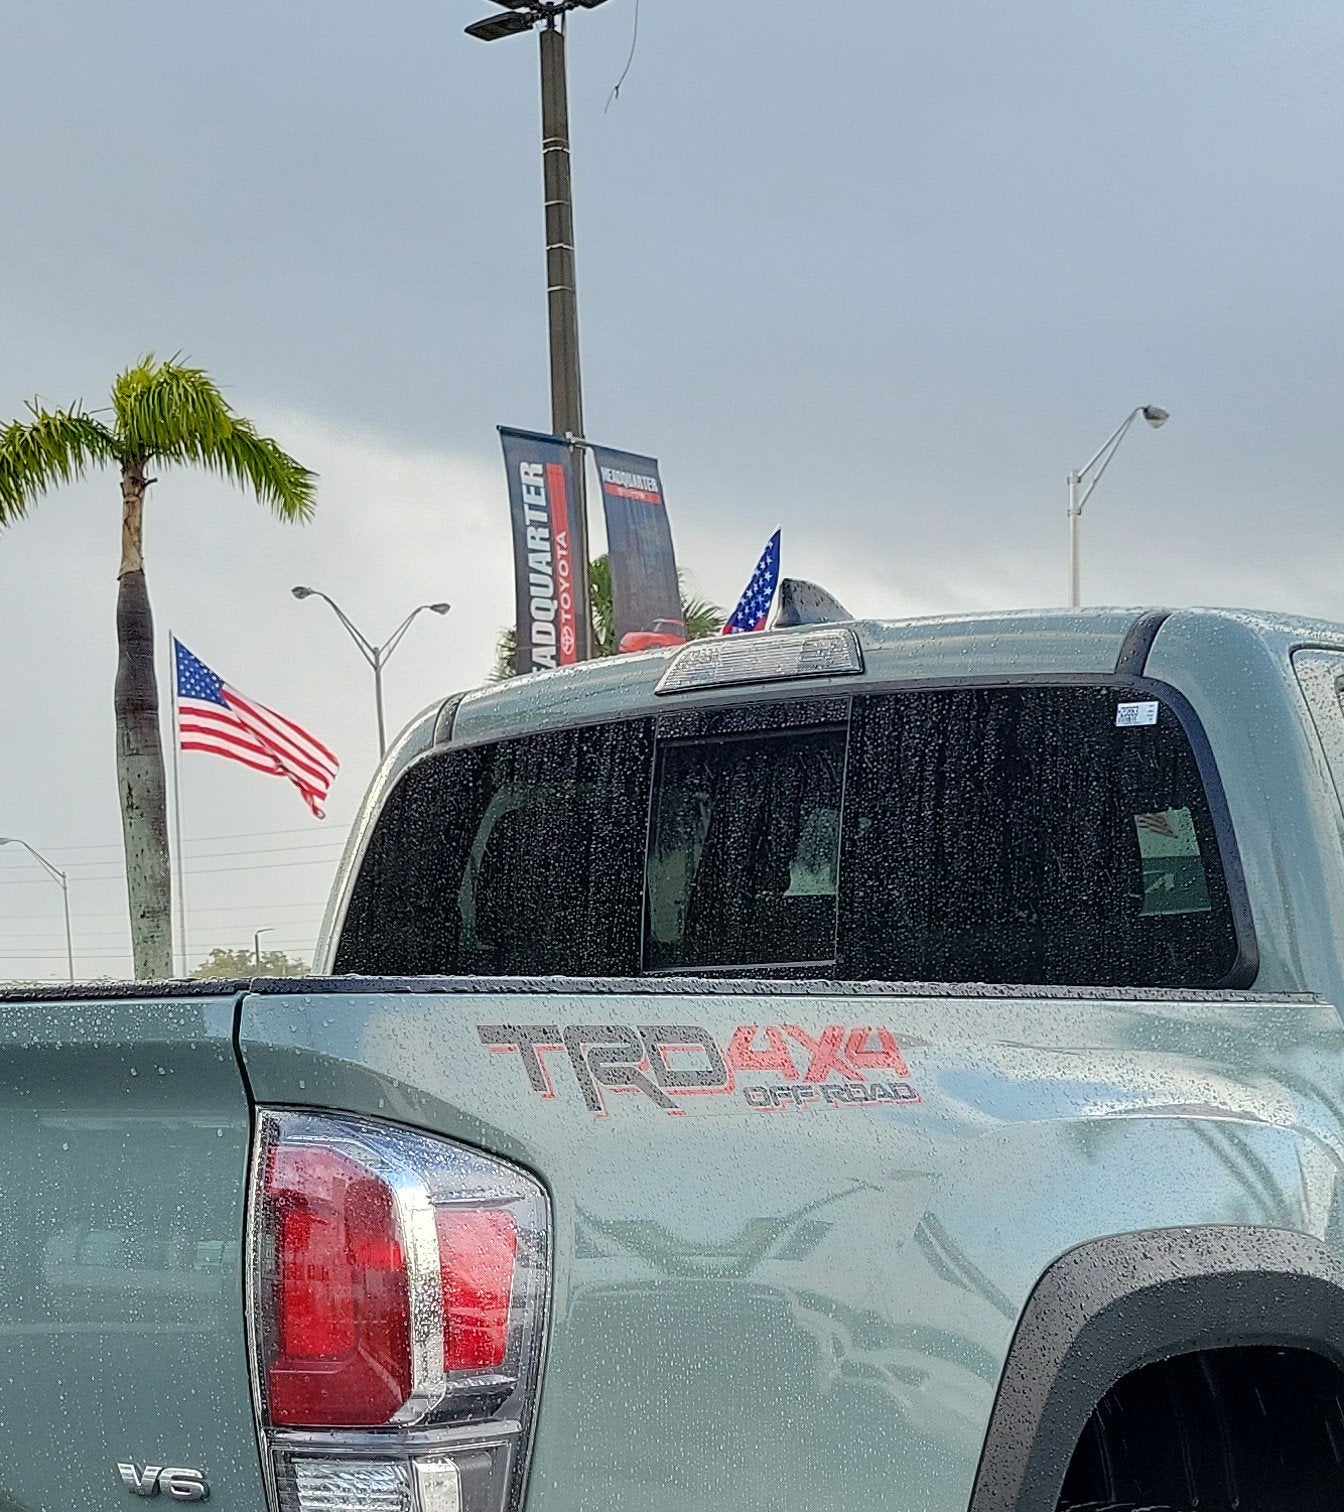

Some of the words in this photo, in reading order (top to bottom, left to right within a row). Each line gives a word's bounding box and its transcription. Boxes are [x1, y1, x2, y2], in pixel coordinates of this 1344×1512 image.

[520, 461, 557, 673] ADQUARTER
[556, 531, 572, 625] TOYOTA
[477, 1025, 735, 1119] TRD
[728, 1023, 910, 1083] 4X4
[743, 1084, 817, 1109] OFF
[819, 1082, 922, 1108] ROAD
[118, 1461, 211, 1501] V6
